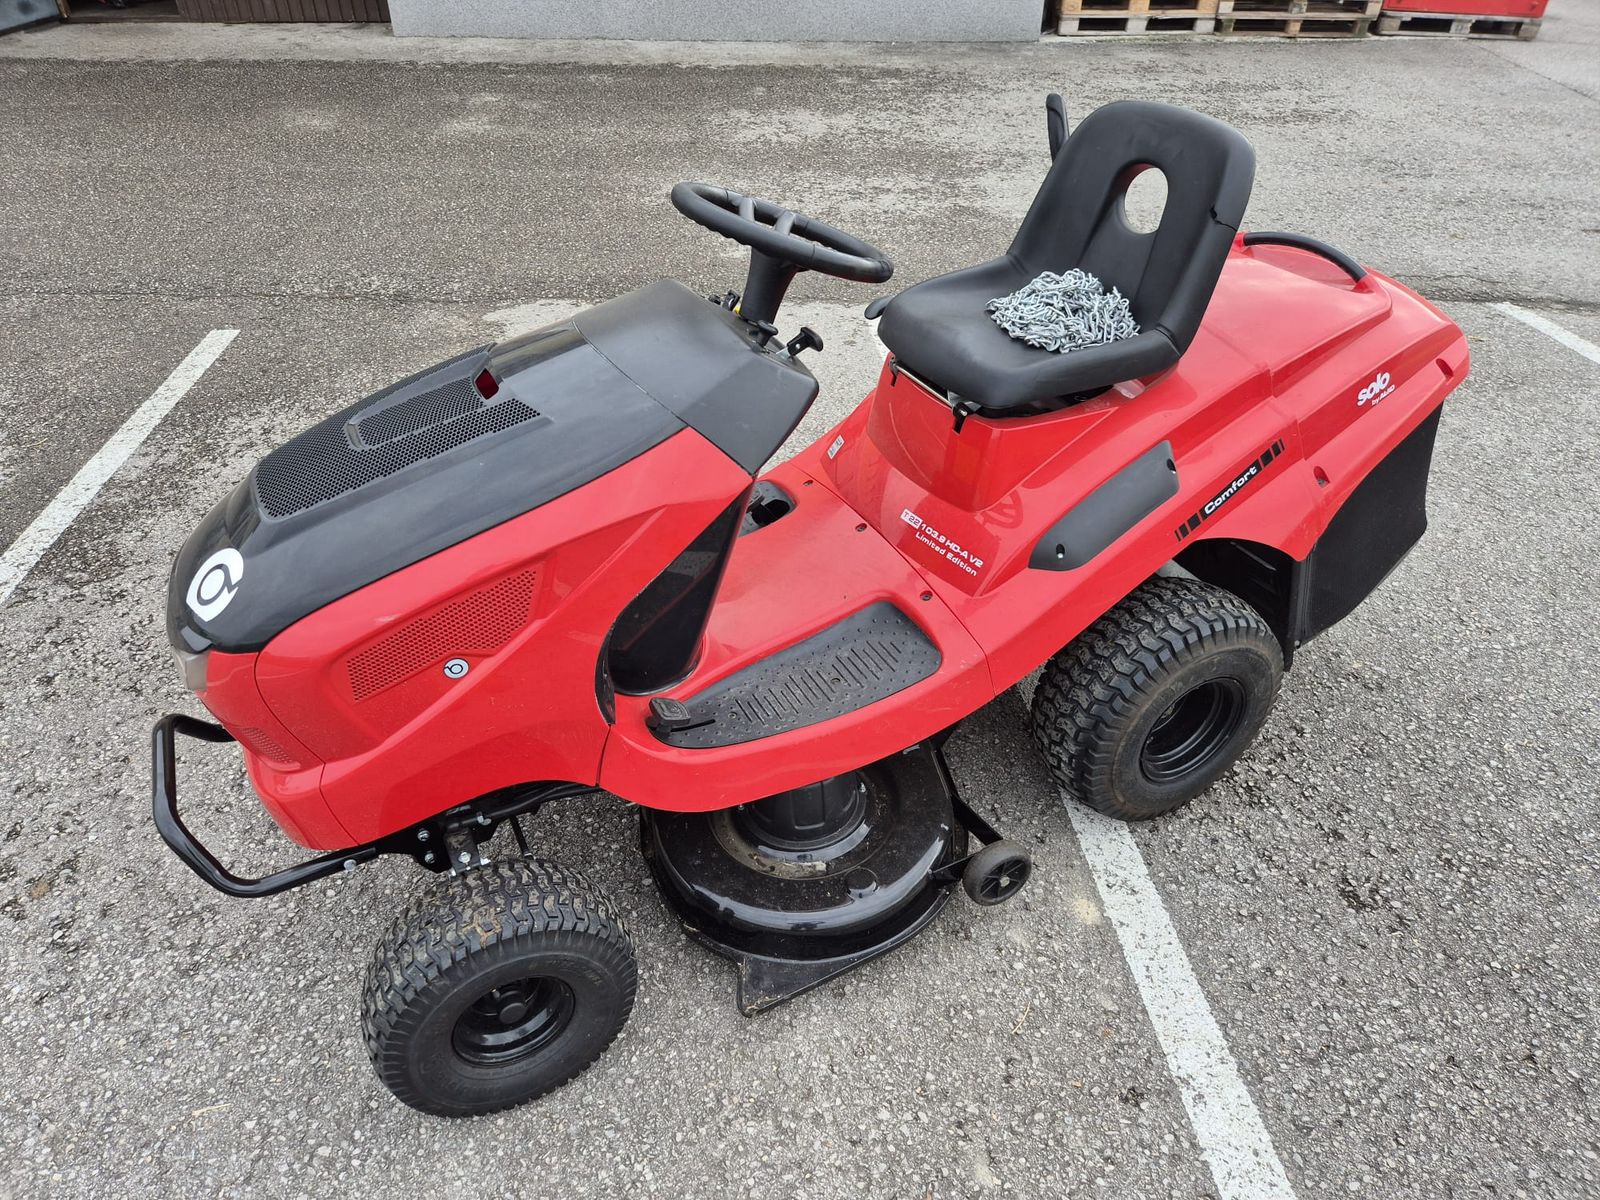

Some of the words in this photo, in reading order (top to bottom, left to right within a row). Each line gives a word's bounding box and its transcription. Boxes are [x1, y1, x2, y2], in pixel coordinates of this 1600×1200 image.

[1357, 372, 1390, 406] solo
[1204, 466, 1257, 515] Comfort
[908, 515, 921, 527] 22
[920, 523, 946, 544] 103.9
[945, 539, 969, 560] HD-A
[969, 554, 984, 568] V2
[915, 531, 947, 556] Limited
[945, 552, 977, 577] Edition
